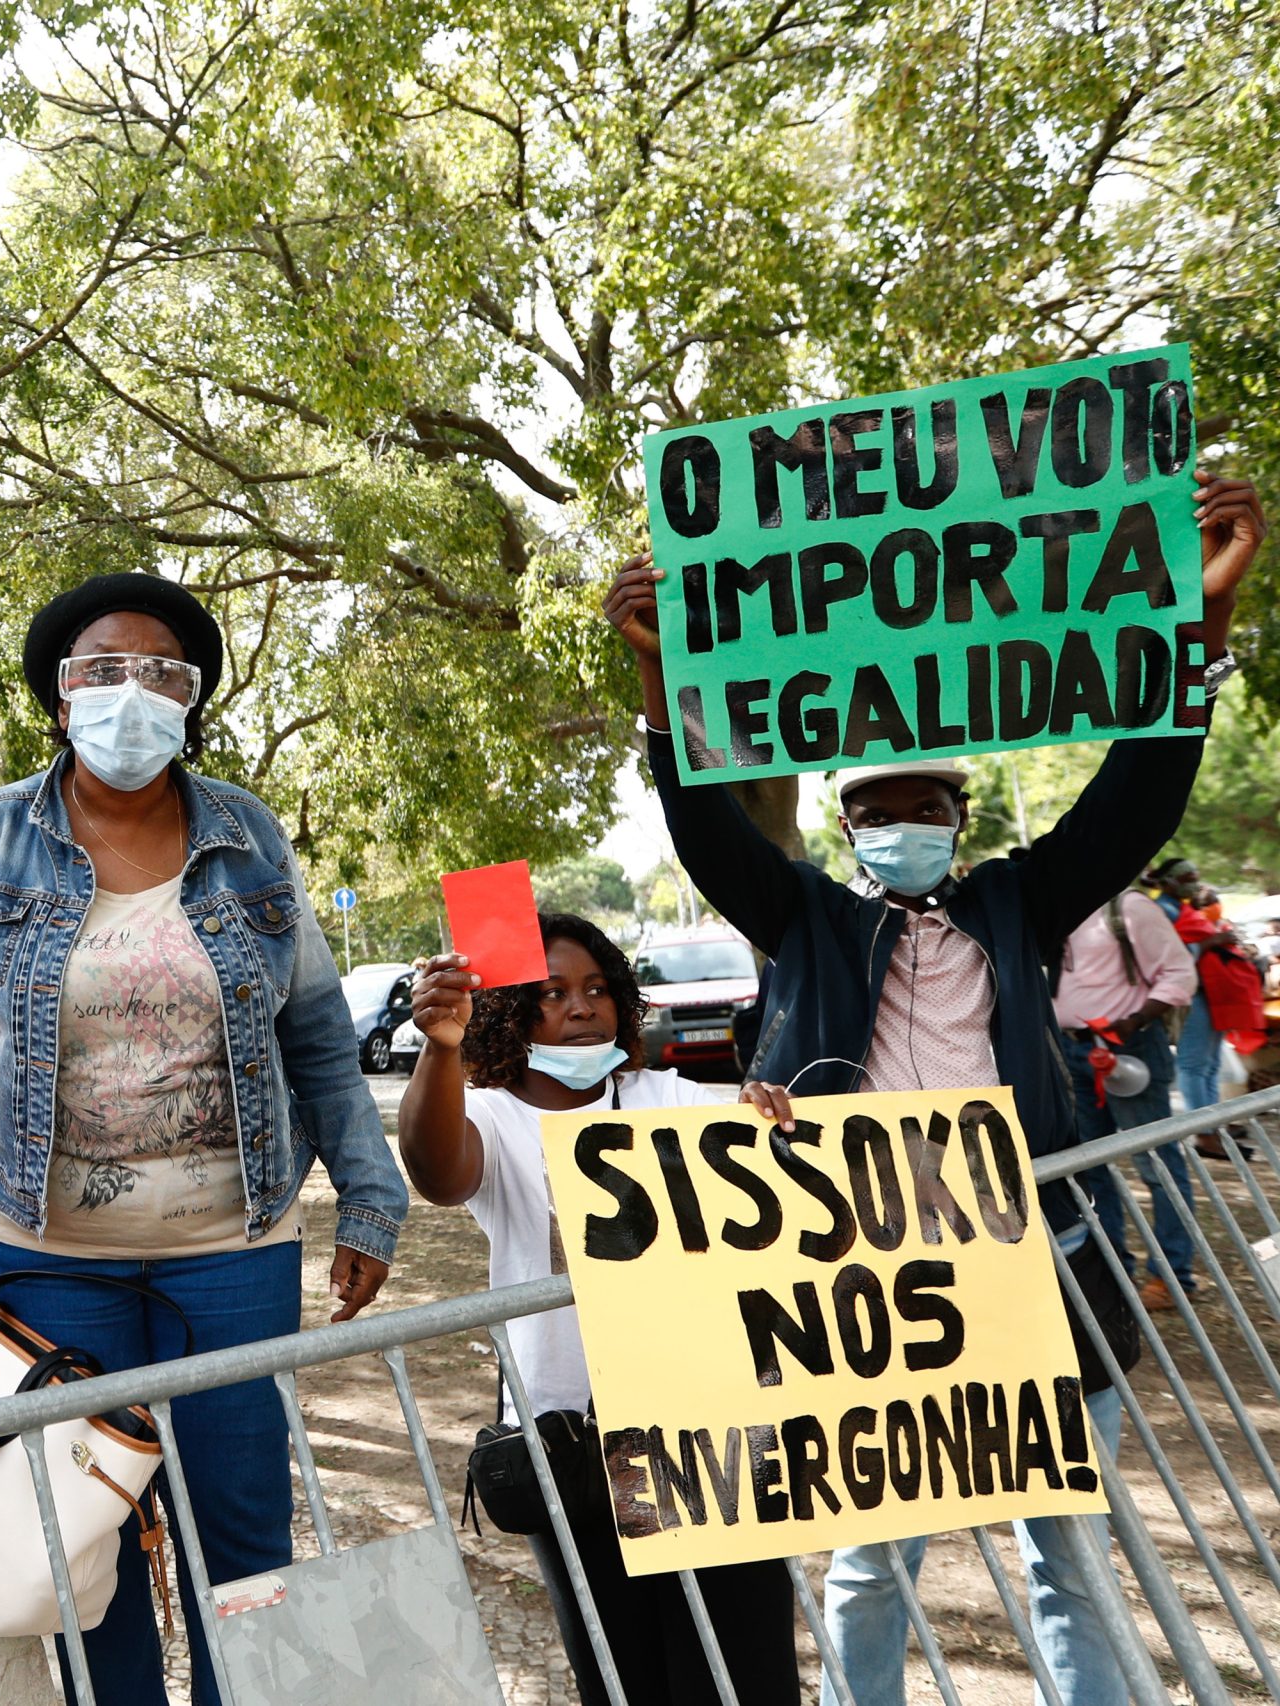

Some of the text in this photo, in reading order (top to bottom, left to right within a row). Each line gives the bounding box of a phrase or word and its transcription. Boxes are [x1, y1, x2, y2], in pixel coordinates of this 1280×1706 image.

[659, 358, 1193, 538] O MEU VOTO
[681, 501, 1178, 654] IMPORTA
[677, 621, 1206, 772] LEGALIDADE
[73, 986, 177, 1021] sunshine
[573, 1099, 1029, 1262] SISSOKO
[737, 1259, 966, 1387] NOS
[603, 1376, 1098, 1539] ENVERGONHA!
